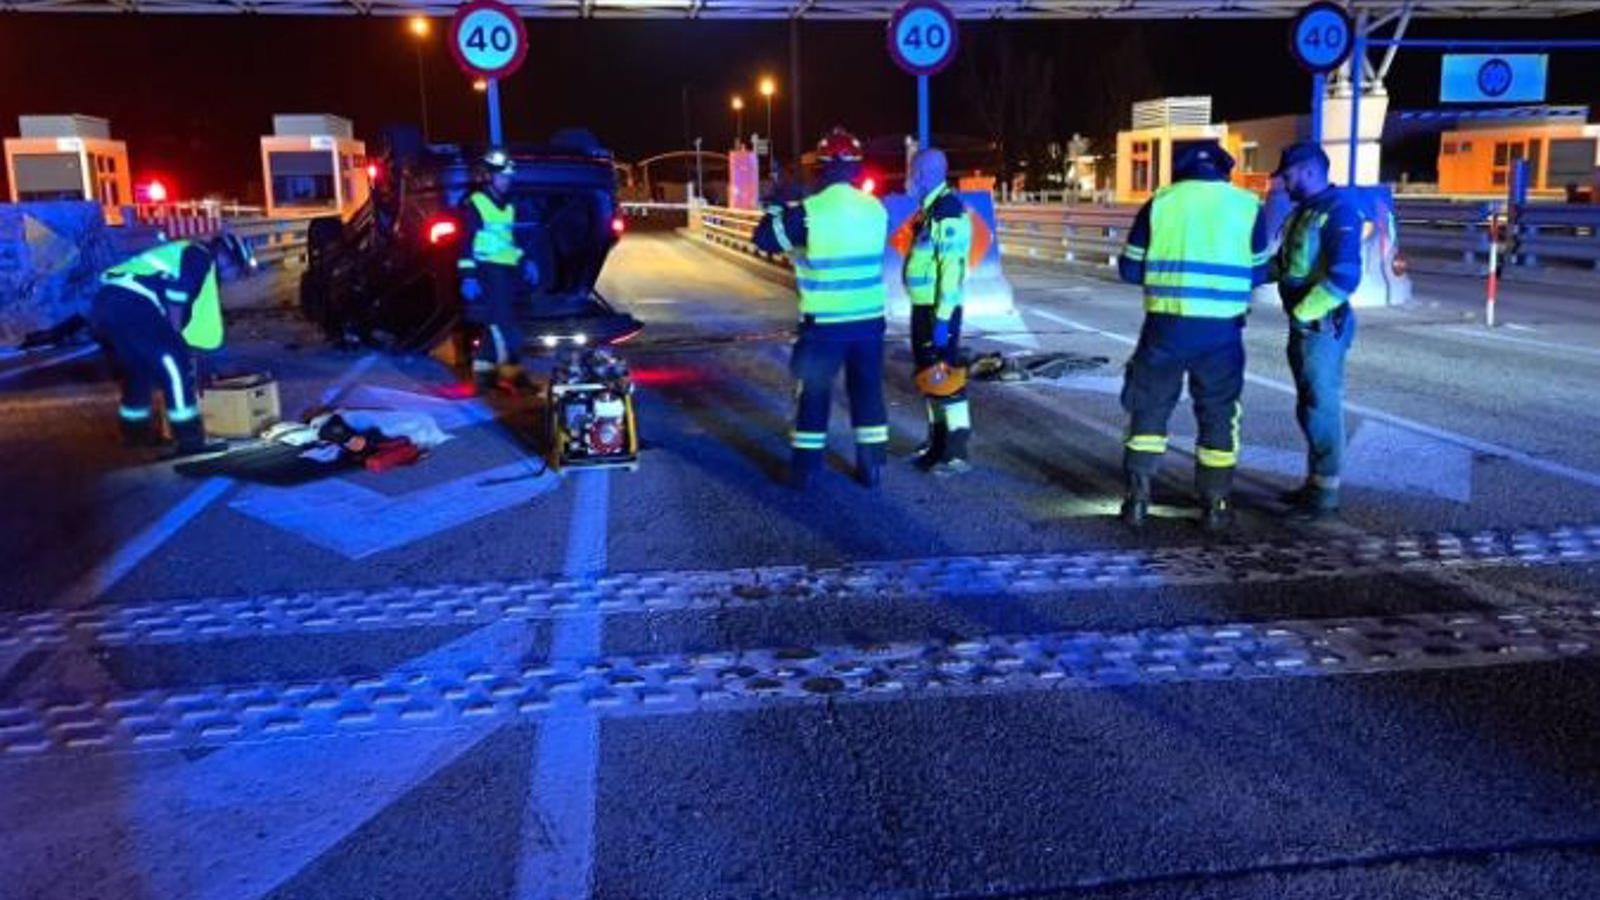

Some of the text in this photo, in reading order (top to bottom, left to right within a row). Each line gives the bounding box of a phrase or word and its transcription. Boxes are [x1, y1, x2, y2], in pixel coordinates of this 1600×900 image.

[466, 25, 512, 52] 40
[903, 24, 945, 49] 40
[1303, 24, 1343, 49] 40
